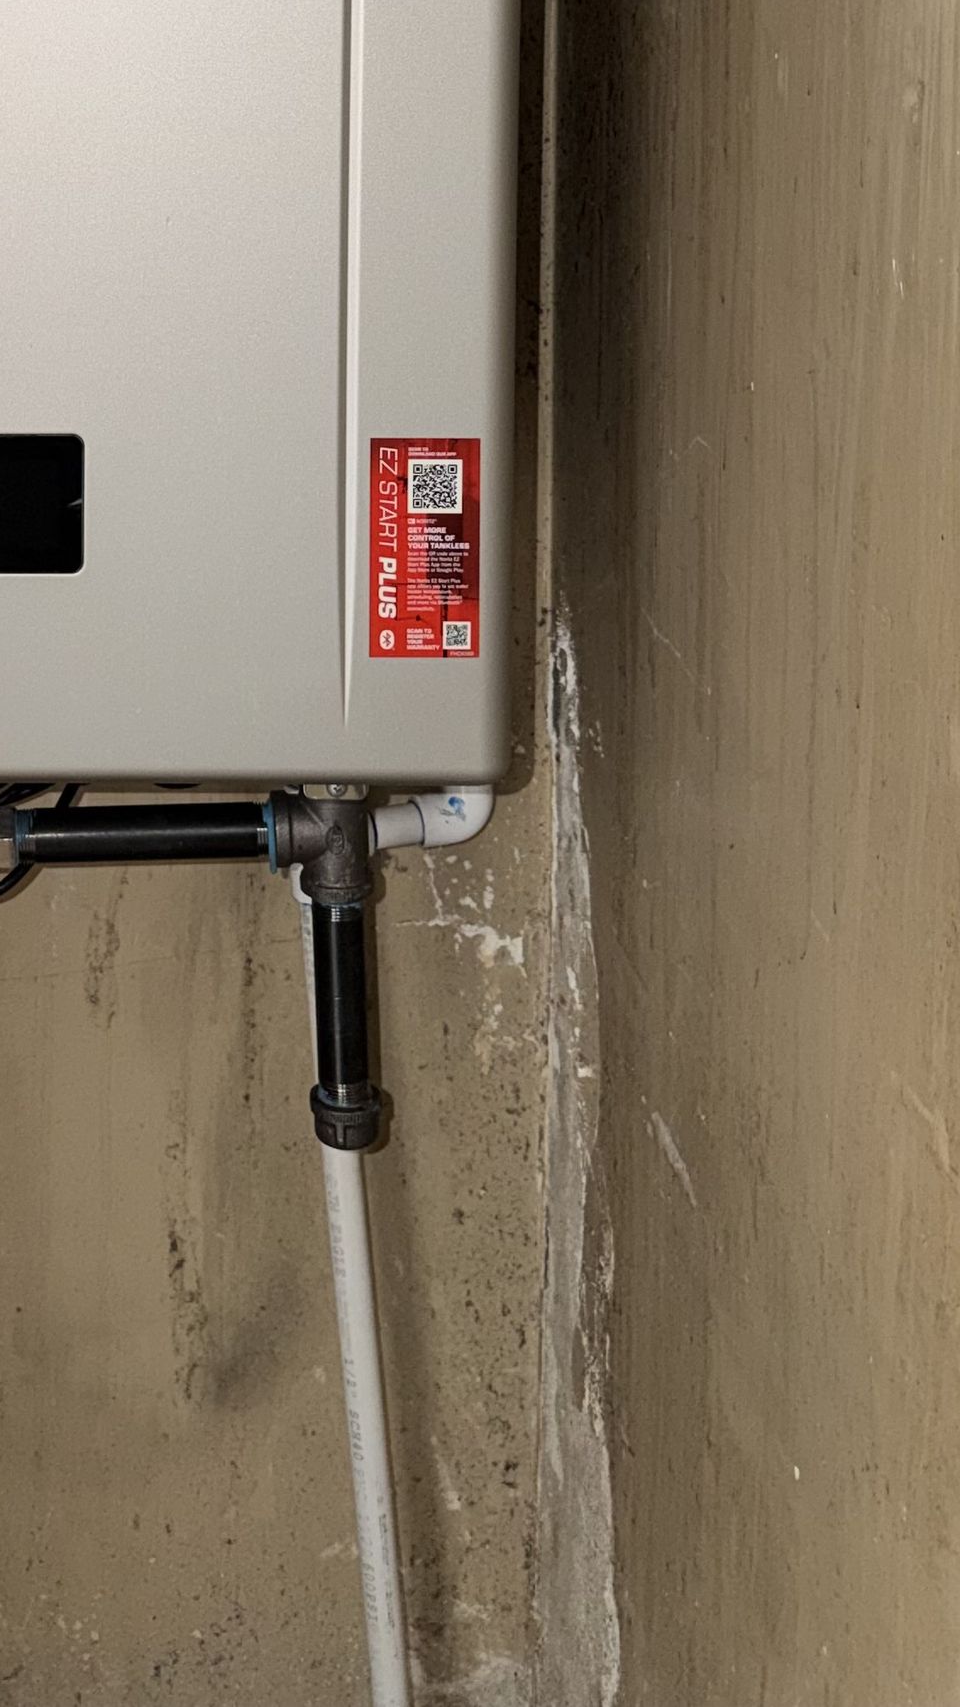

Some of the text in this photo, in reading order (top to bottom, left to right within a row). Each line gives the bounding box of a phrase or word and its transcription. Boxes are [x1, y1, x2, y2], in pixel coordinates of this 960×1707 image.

[378, 447, 398, 619] EZ START PLUS
[330, 1222, 346, 1279] EAGLE
